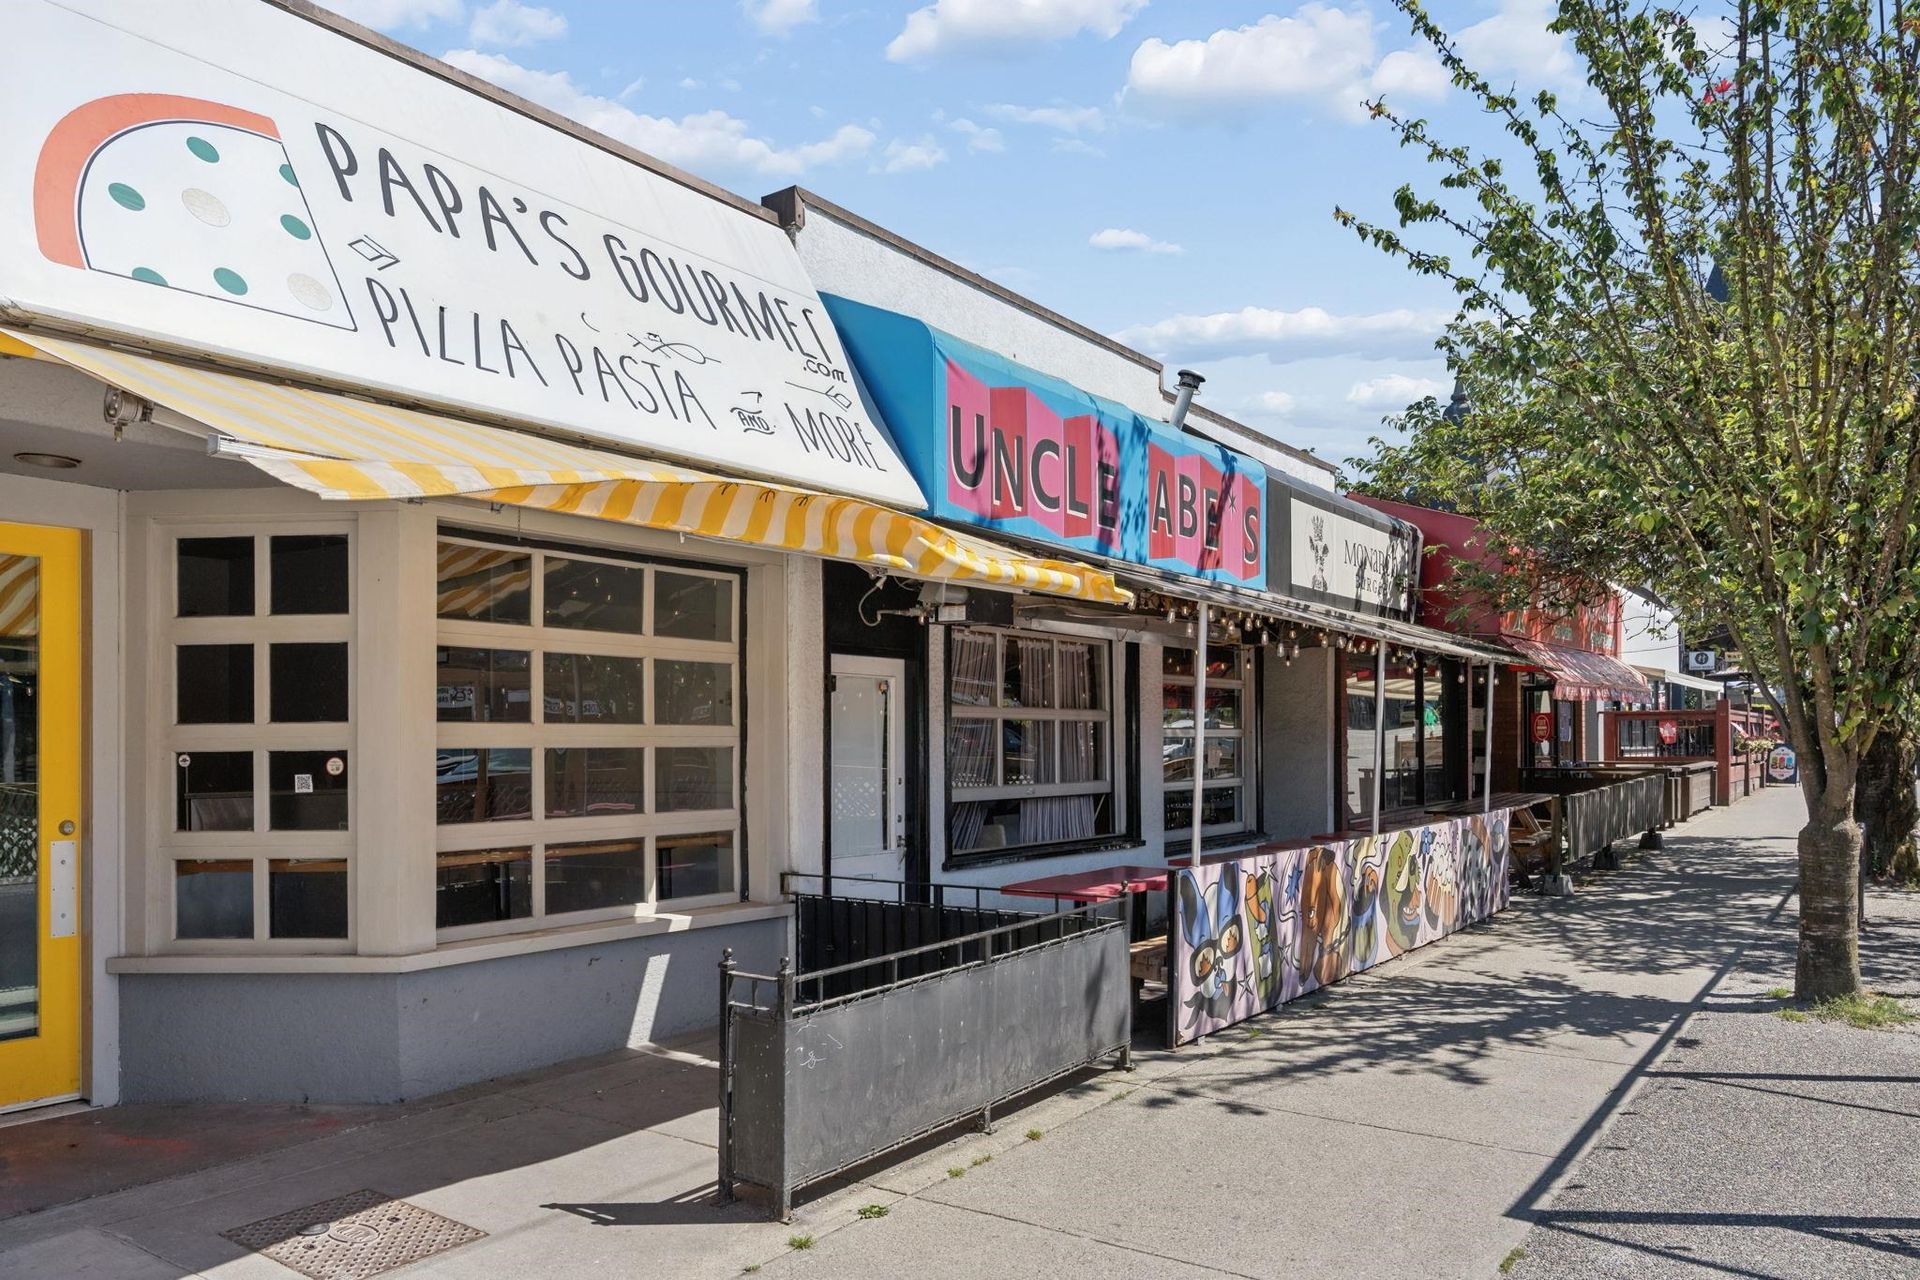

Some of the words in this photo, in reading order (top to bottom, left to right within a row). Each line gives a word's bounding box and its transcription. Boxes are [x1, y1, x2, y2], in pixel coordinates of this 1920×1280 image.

[314, 121, 591, 281] PAPA'S
[554, 332, 718, 430] PASTA
[737, 410, 770, 431] AND
[783, 401, 888, 473] MORE
[950, 404, 1116, 532] UNCLE
